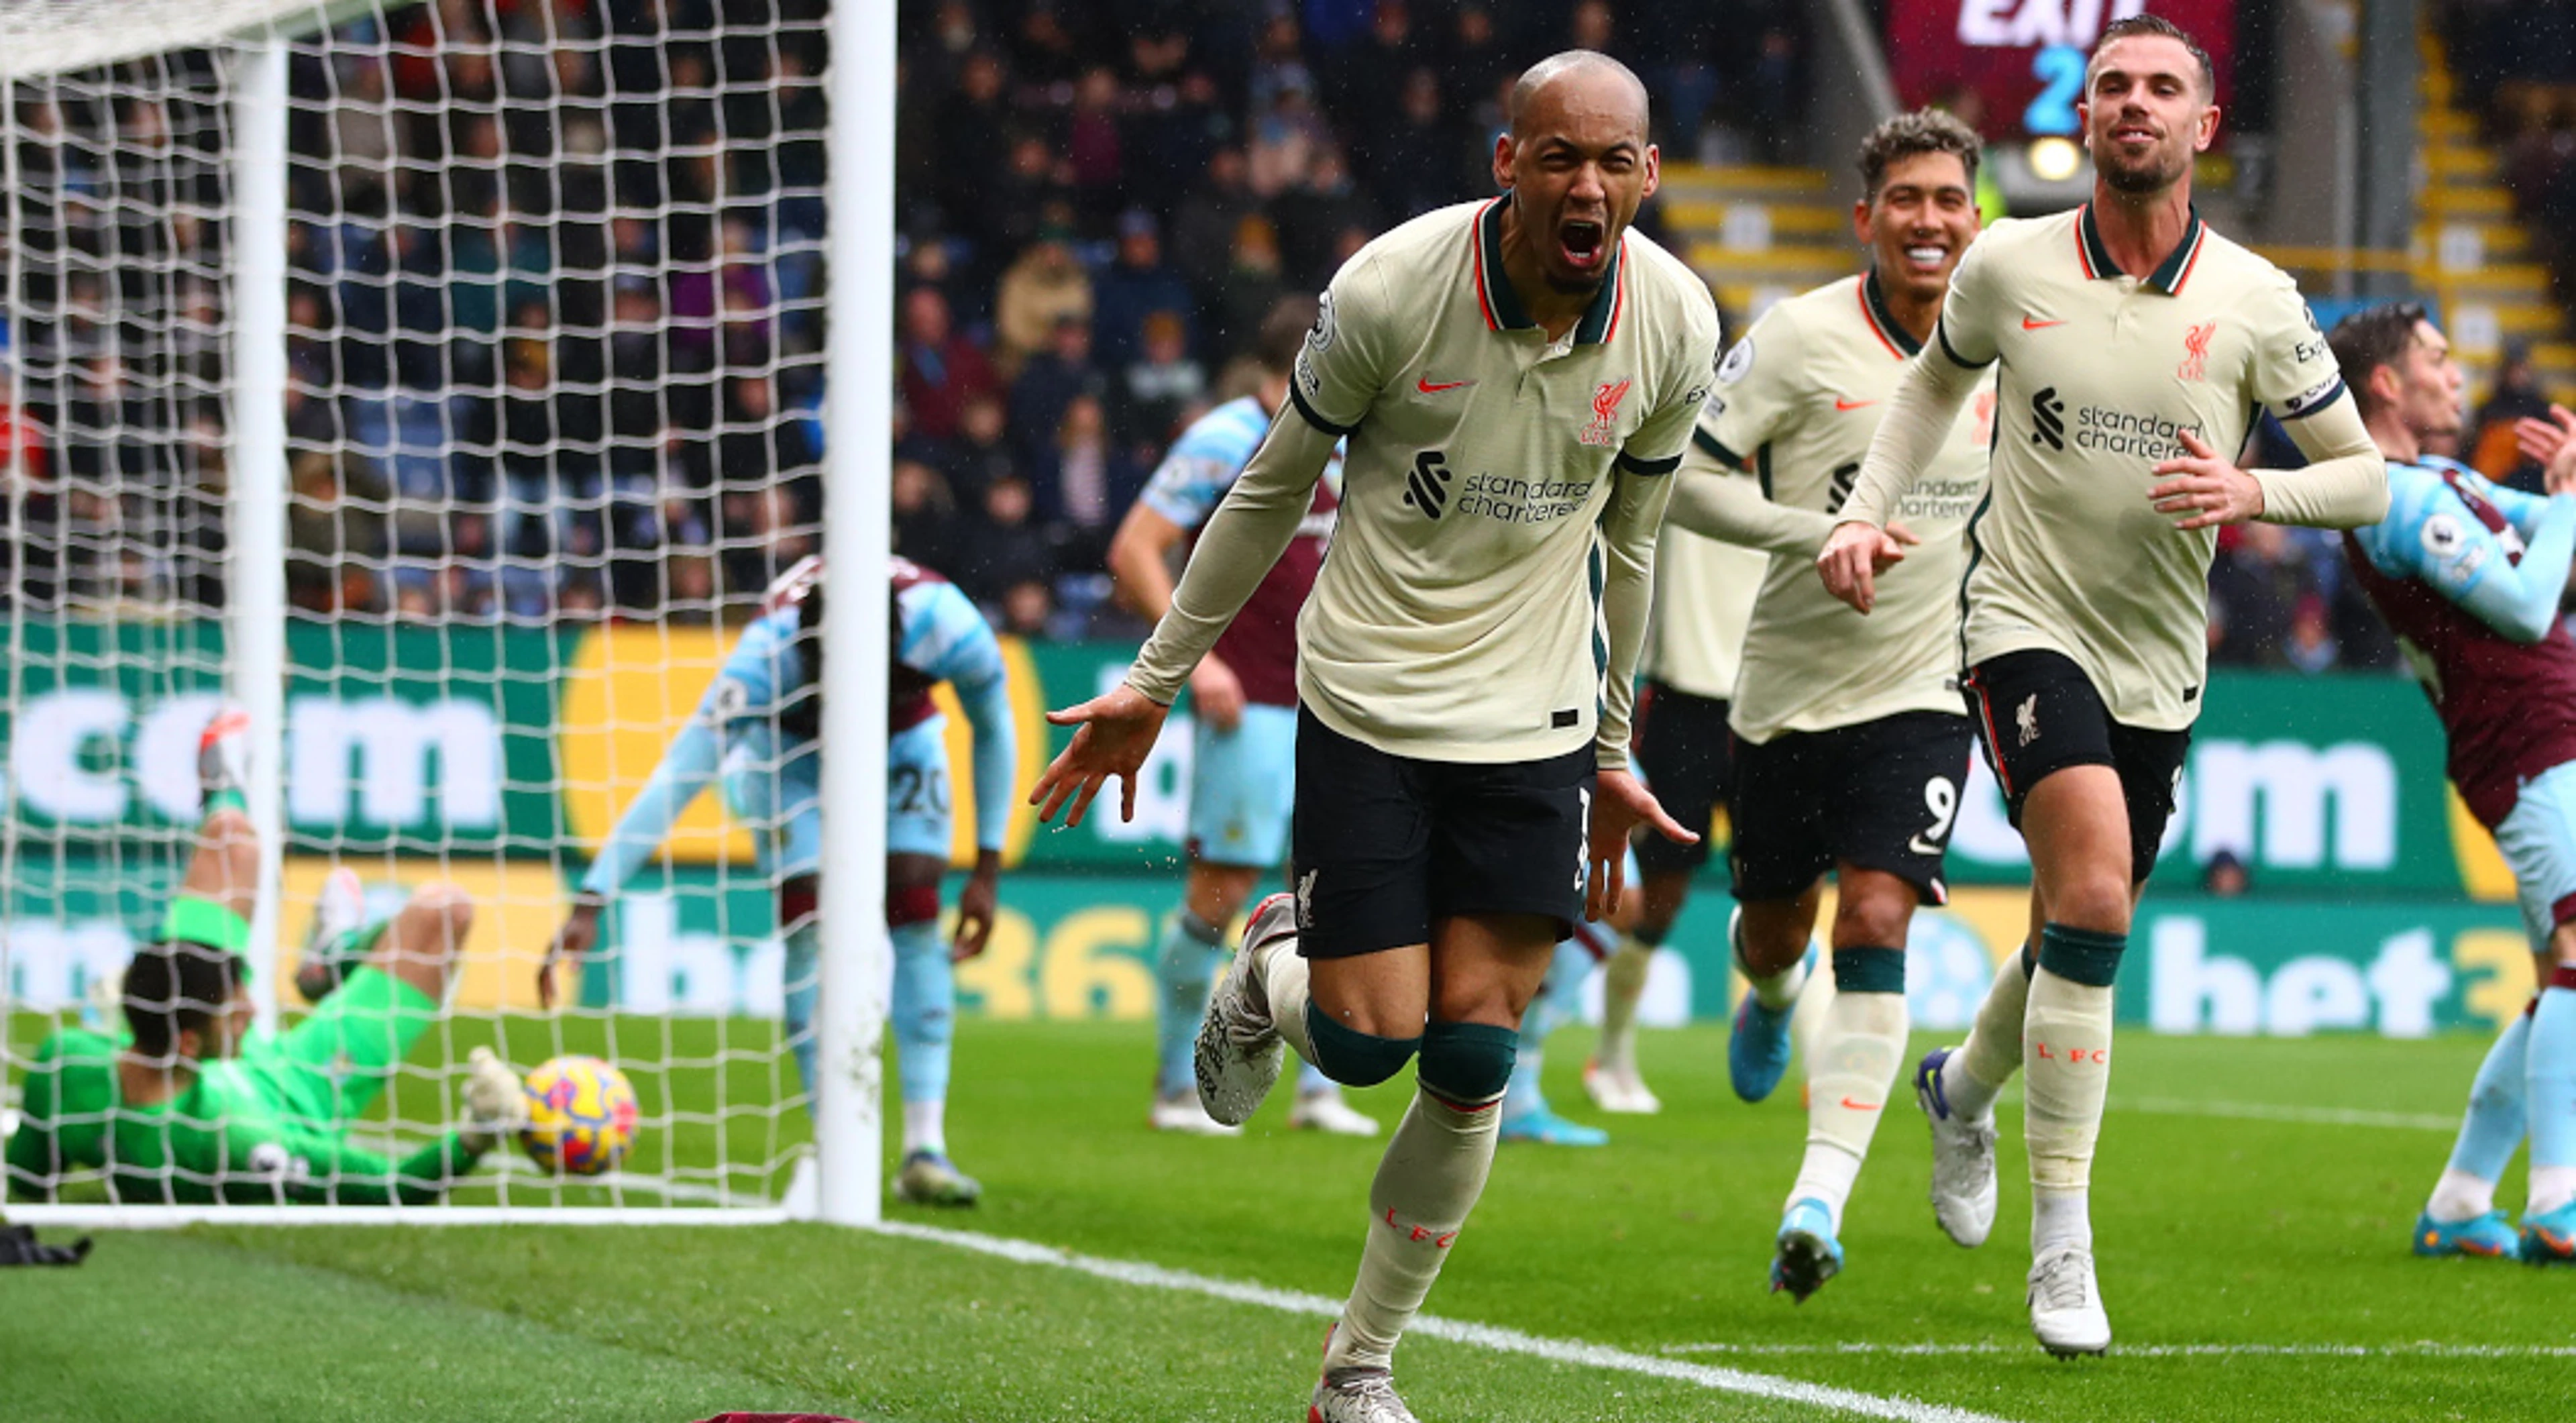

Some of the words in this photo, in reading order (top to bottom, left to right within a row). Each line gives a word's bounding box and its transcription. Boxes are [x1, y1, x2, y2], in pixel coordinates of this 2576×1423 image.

[2023, 44, 2088, 133] 2
[2078, 405, 2204, 439] standard
[2077, 429, 2192, 460] chartere
[1464, 471, 1596, 499] standard
[1925, 776, 1955, 841] 9
